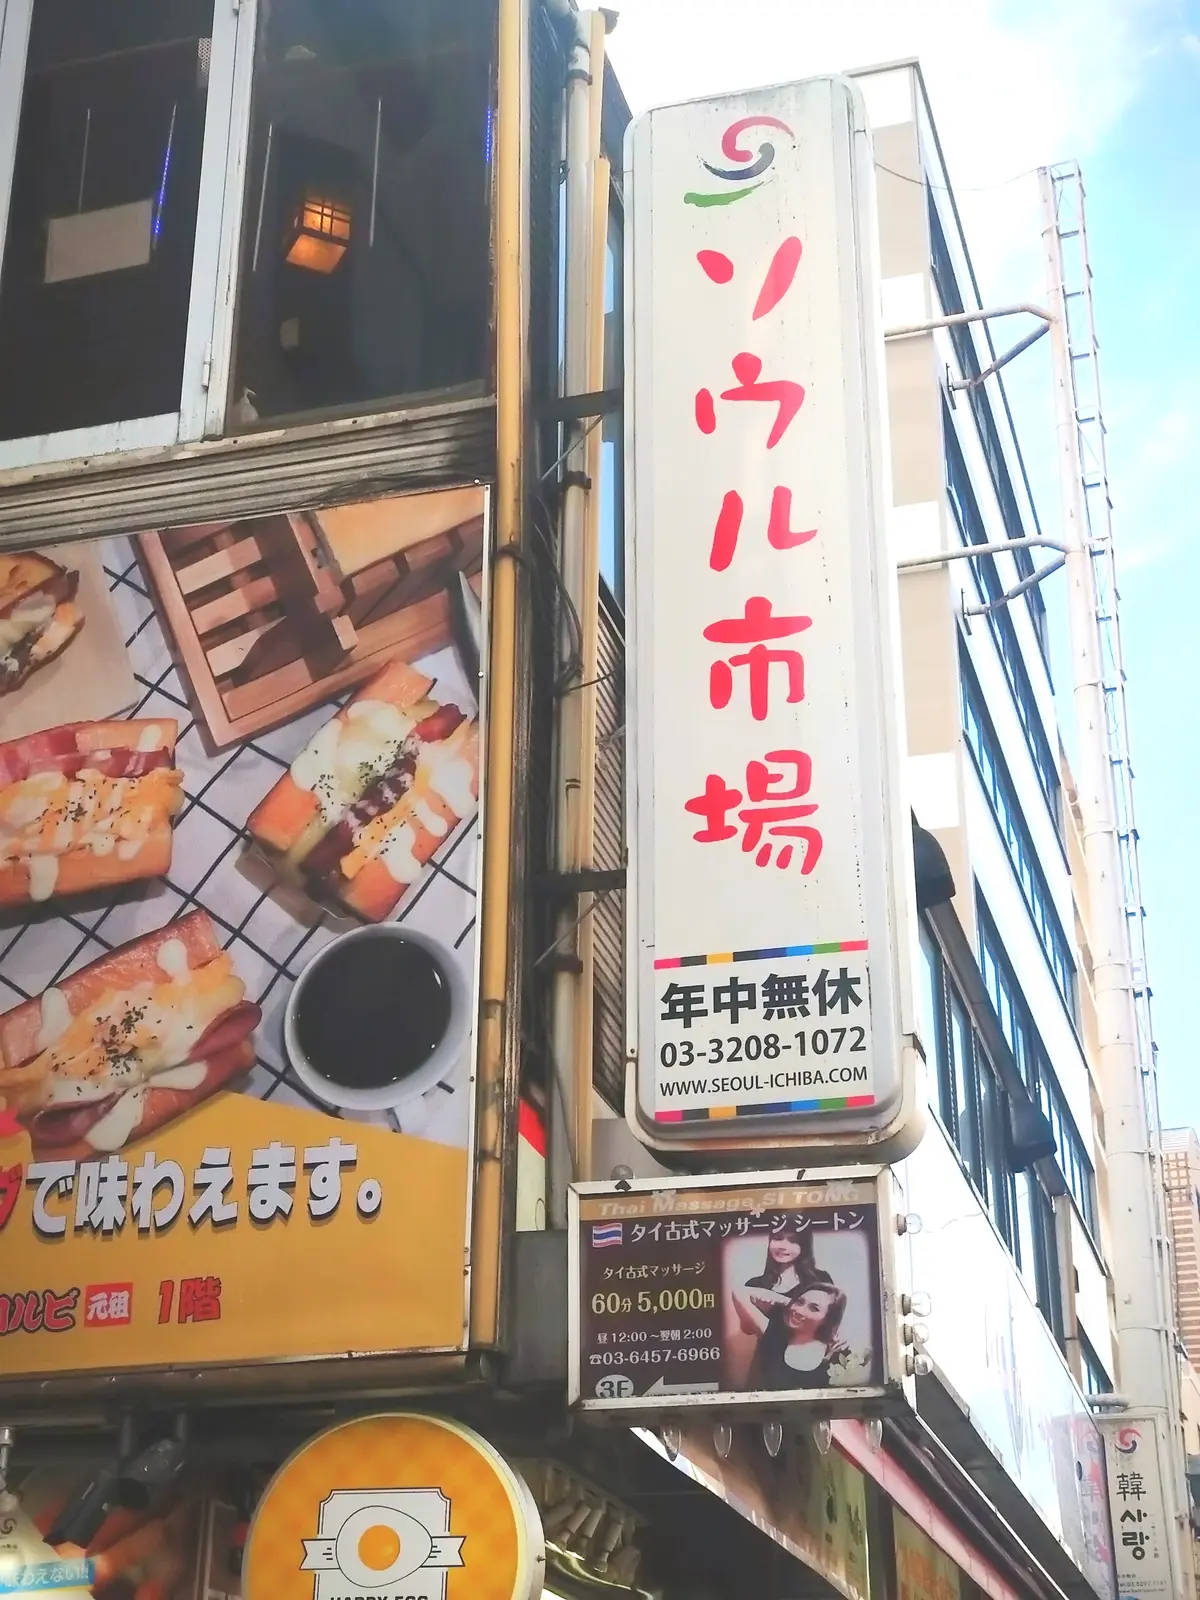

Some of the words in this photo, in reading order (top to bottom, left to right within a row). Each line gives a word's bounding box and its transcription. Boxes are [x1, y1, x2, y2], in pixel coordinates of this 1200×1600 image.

[685, 235, 822, 875] ソウル市場
[660, 967, 863, 1029] 年中無休
[660, 1026, 867, 1068] 03-3208-1072
[660, 1066, 868, 1096] WWW.SEOUL-ICHIBA.COM
[600, 1202, 645, 1217] Thai
[631, 1215, 787, 1243] タイ古式マッサージ
[796, 1211, 865, 1232] シートン
[603, 1261, 706, 1280] タイ古式マッサージ
[87, 1290, 130, 1320] 元祖
[158, 1276, 222, 1324] 1階
[591, 1292, 632, 1314] 60分
[637, 1288, 715, 1314] 5,000円
[611, 1331, 647, 1344] 12:00
[683, 1328, 712, 1340] 2:00
[602, 1346, 721, 1365] 03-6457-6966
